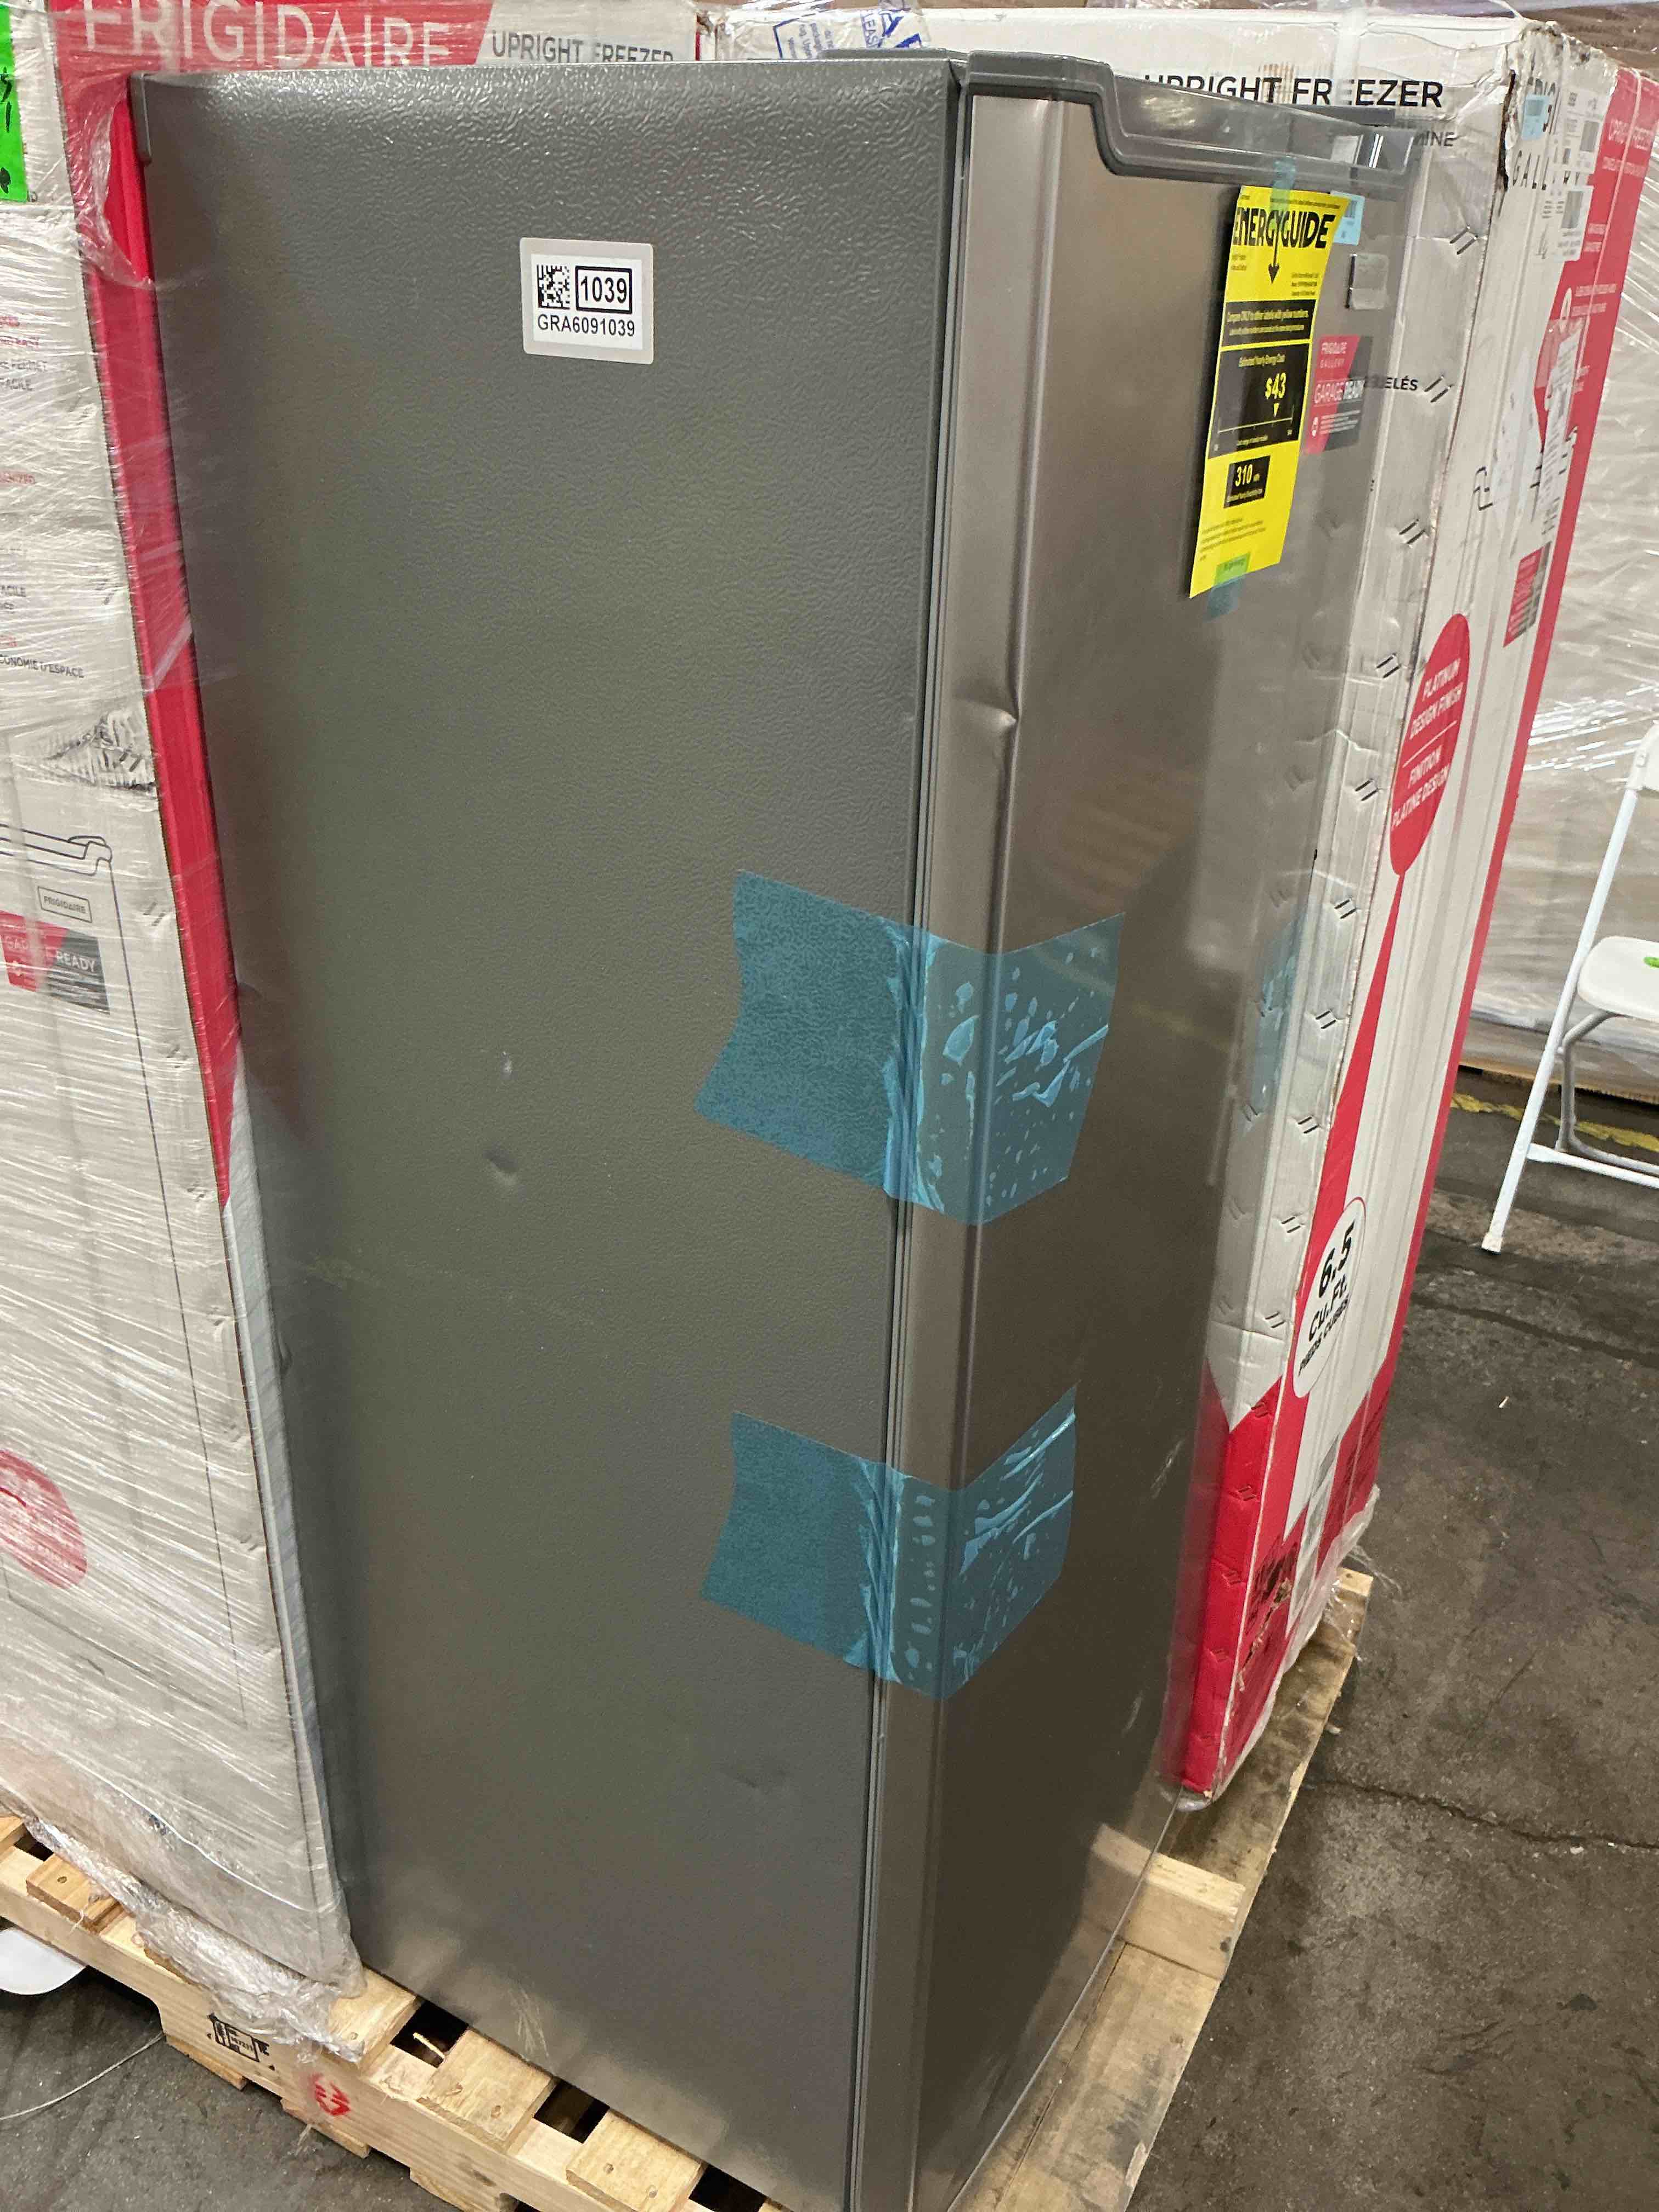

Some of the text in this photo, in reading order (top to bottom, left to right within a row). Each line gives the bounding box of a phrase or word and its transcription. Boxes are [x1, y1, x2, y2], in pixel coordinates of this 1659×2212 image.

[82, 0, 451, 68] FRIGIDAIRE
[492, 30, 584, 63] UPRIGHT
[1145, 75, 1443, 108] RIGHT FREZER
[580, 275, 627, 303] 1039
[538, 313, 635, 337] GRA6091039
[1265, 373, 1287, 400] $43
[1235, 464, 1253, 487] 310
[1318, 1220, 1355, 1298] 6.5
